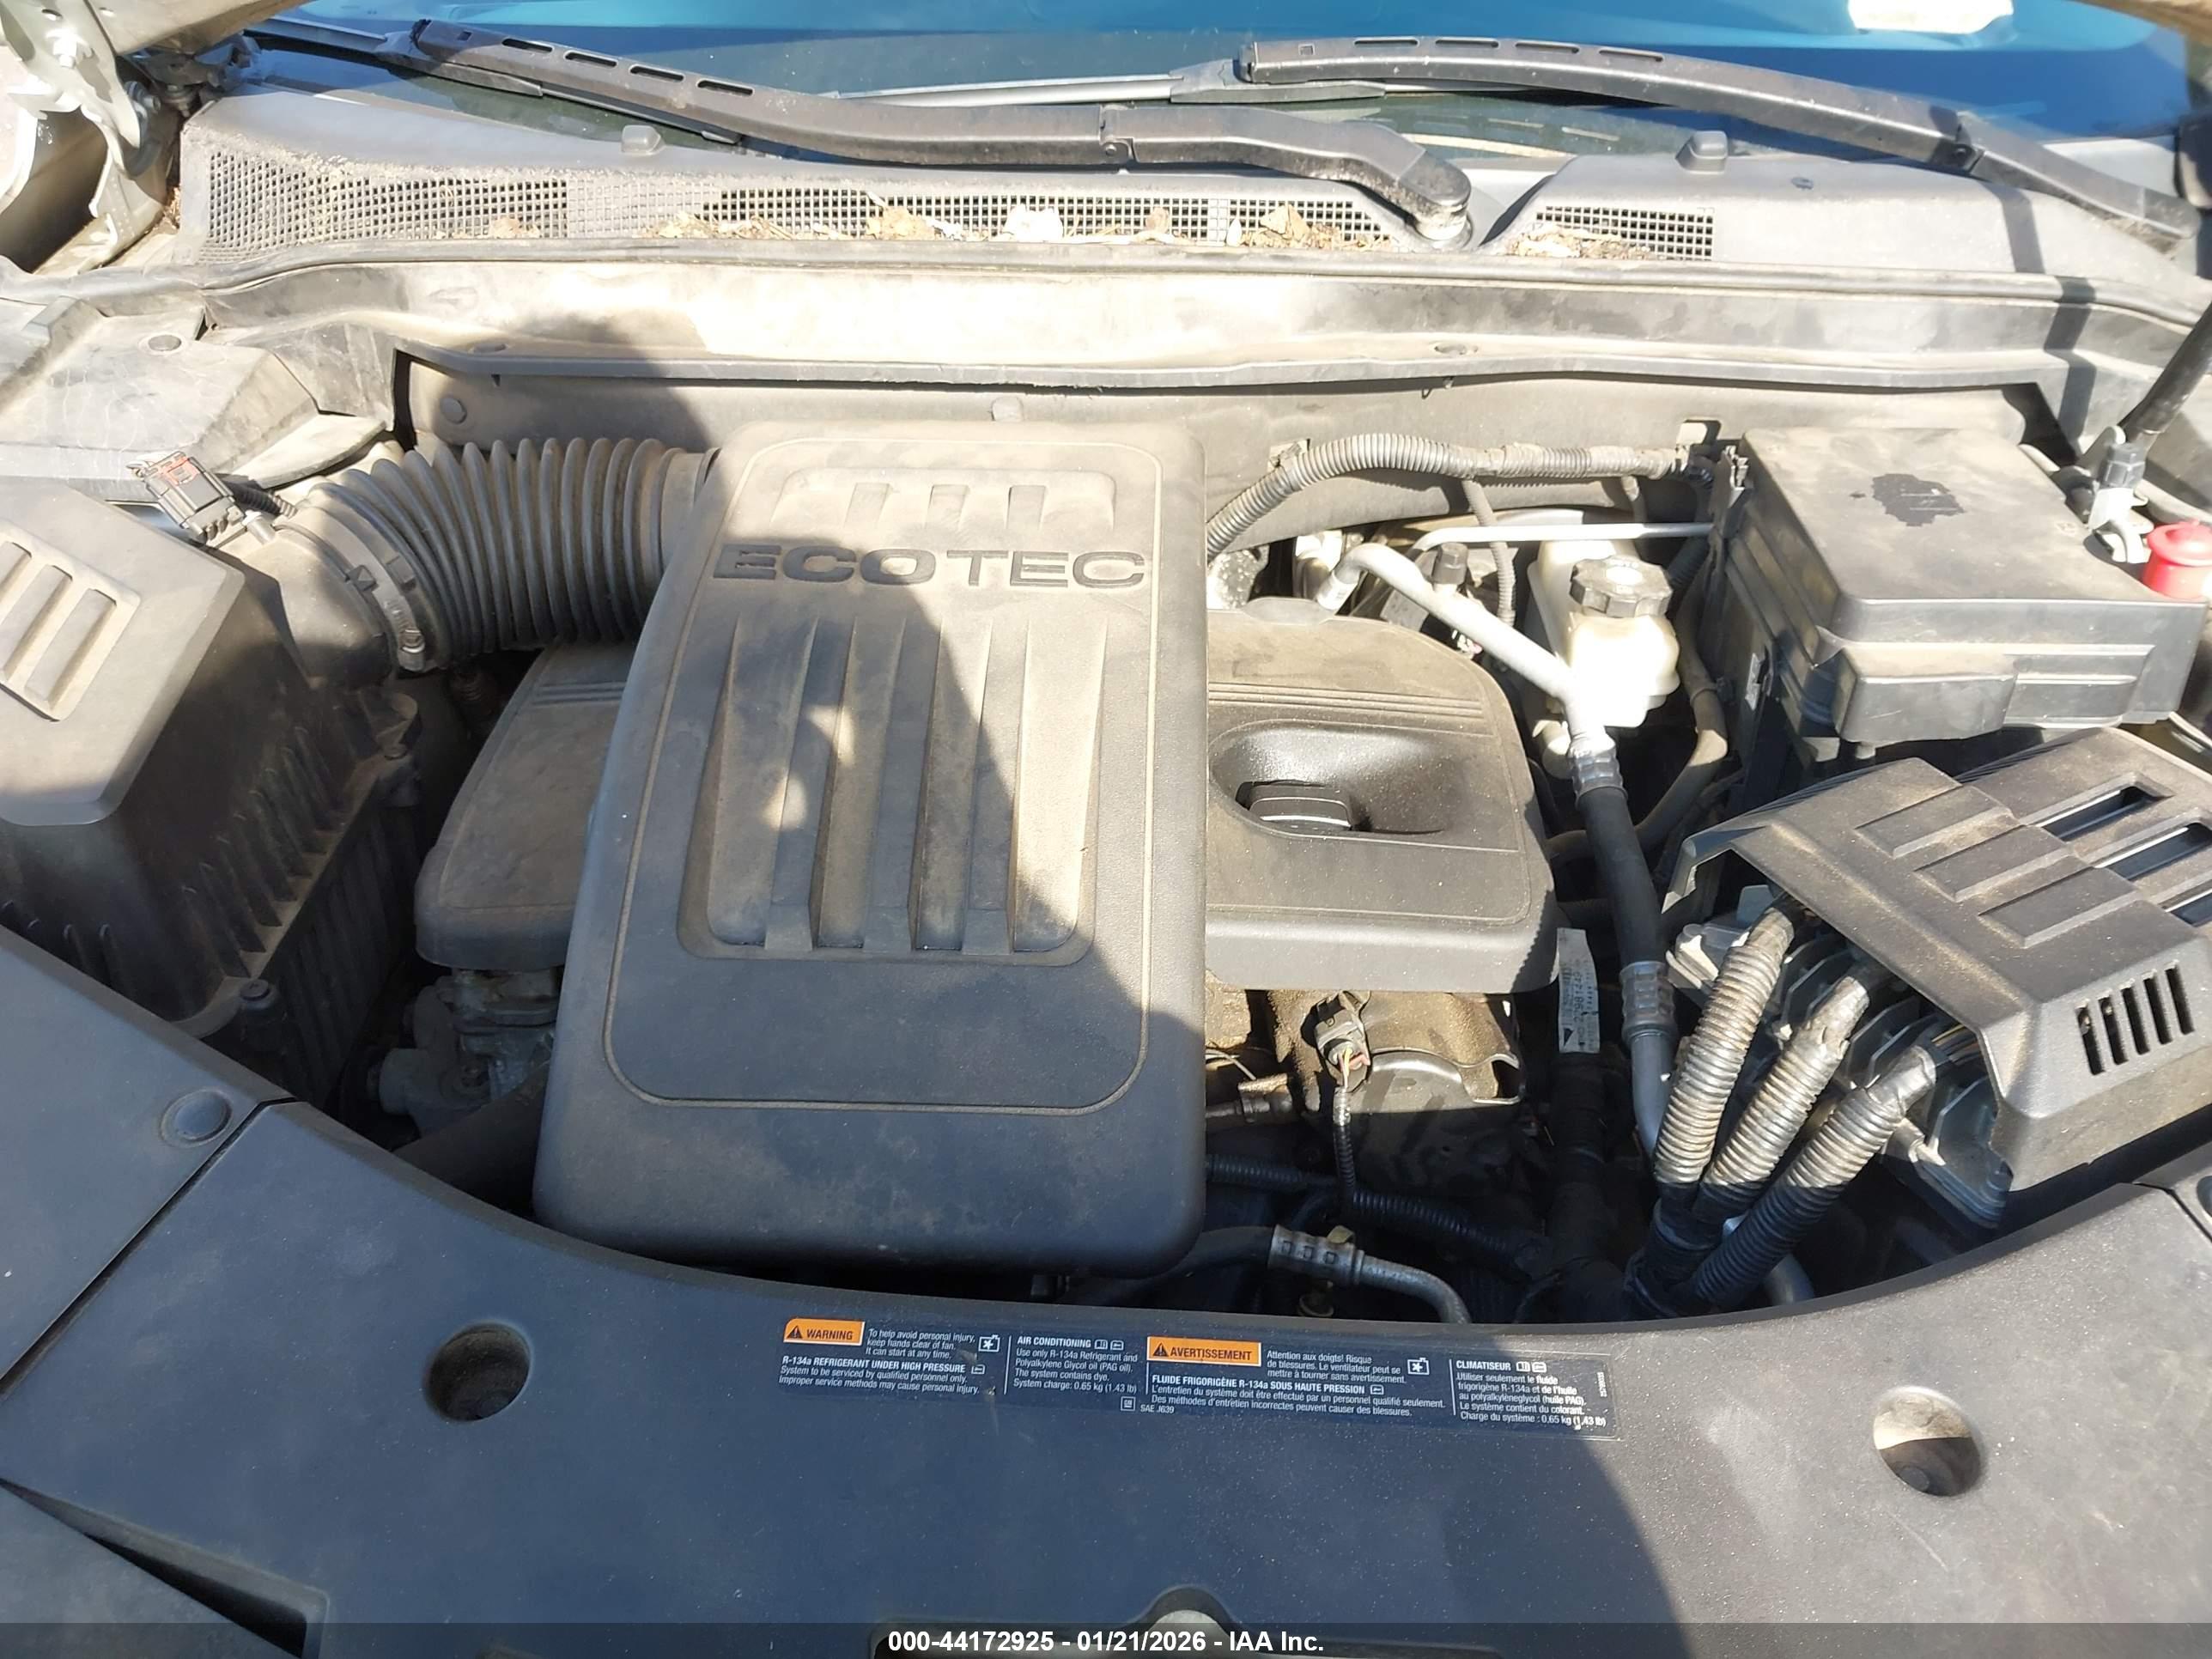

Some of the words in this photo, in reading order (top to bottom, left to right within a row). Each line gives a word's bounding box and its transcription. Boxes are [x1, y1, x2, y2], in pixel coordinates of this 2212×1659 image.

[713, 544, 1146, 588] ECOTEC
[807, 1329, 853, 1340] WARNING
[869, 1328, 878, 1337] To
[879, 1329, 895, 1339] help
[919, 1332, 951, 1340] personal
[888, 1339, 910, 1347] hands
[1018, 1336, 1031, 1345] AIR
[1034, 1336, 1091, 1348] CONDITIONING
[888, 1348, 908, 1357] start
[1017, 1348, 1030, 1357] Use
[1032, 1349, 1048, 1358] only
[1050, 1350, 1078, 1358] R-134a
[1080, 1351, 1121, 1362] Refrigerant
[1123, 1353, 1138, 1362] and
[1170, 1347, 1252, 1360] AVERTISSEMENT
[1267, 1350, 1300, 1360] Attention
[1346, 1354, 1372, 1364] Risque
[782, 1356, 811, 1365] R-134a
[813, 1357, 870, 1368] REFRIGERANT
[872, 1360, 899, 1370] UNDER
[901, 1361, 921, 1370] HIGH
[923, 1363, 966, 1372] PRESSURE
[1016, 1358, 1061, 1369] Polyalkylene
[1064, 1360, 1087, 1370] Glycol
[1100, 1362, 1117, 1372] (PAG
[1319, 1362, 1328, 1370] Le
[1330, 1363, 1370, 1373] ventilateur
[1456, 1360, 1511, 1370] CLIMATISEUR
[781, 1365, 809, 1376] System
[820, 1367, 830, 1376] be
[831, 1369, 864, 1377] serviced
[866, 1370, 875, 1379] by
[877, 1370, 908, 1380] qualified
[911, 1372, 948, 1381] personnel
[1015, 1368, 1029, 1376] The
[1030, 1370, 1058, 1379] system
[1060, 1371, 1091, 1381] contains
[1294, 1370, 1300, 1378] à
[1302, 1370, 1329, 1379] tourner
[1456, 1372, 1484, 1381] Utiliser
[1486, 1374, 1525, 1382] seulement
[1535, 1375, 1558, 1385] fluide
[779, 1376, 814, 1386] Improper
[815, 1377, 842, 1386] service
[844, 1379, 878, 1388] methods
[879, 1382, 895, 1391] may
[922, 1383, 955, 1392] personal
[1013, 1377, 1042, 1388] System
[1044, 1379, 1072, 1390] charge:
[1073, 1382, 1091, 1390] 0.65
[1093, 1382, 1103, 1393] kg
[1127, 1384, 1137, 1395] lb)
[1152, 1375, 1181, 1384] FLUIDE
[1183, 1376, 1237, 1387] FRIGORIGÈNE
[1239, 1379, 1268, 1389] R-134a
[1271, 1381, 1292, 1389] SOUS
[1295, 1382, 1322, 1391] HAUTE
[1324, 1384, 1364, 1394] PRESSION
[1458, 1382, 1499, 1392] frigorigène
[1501, 1383, 1530, 1393] R-134a
[1194, 1387, 1203, 1395] du
[1206, 1388, 1237, 1397] système
[1240, 1389, 1254, 1398] doit
[1256, 1390, 1271, 1399] être
[1273, 1391, 1304, 1401] effectué
[1333, 1395, 1370, 1405] personnel
[1373, 1396, 1401, 1407] qualifié
[1542, 1395, 1564, 1405] (huile
[1152, 1395, 1166, 1403] Des
[1169, 1395, 1206, 1405] méthodes
[1252, 1400, 1293, 1411] incorrectes
[1296, 1404, 1326, 1413] peuvent
[1357, 1406, 1370, 1414] des
[1157, 1405, 1174, 1413] J639
[1460, 1401, 1469, 1410] Le
[1472, 1403, 1504, 1412] système
[1506, 1405, 1537, 1413] contient
[1461, 1411, 1489, 1422] Charge
[1503, 1413, 1535, 1423] système
[1561, 1415, 1571, 1425] kg
[1595, 1417, 1606, 1427] lb)
